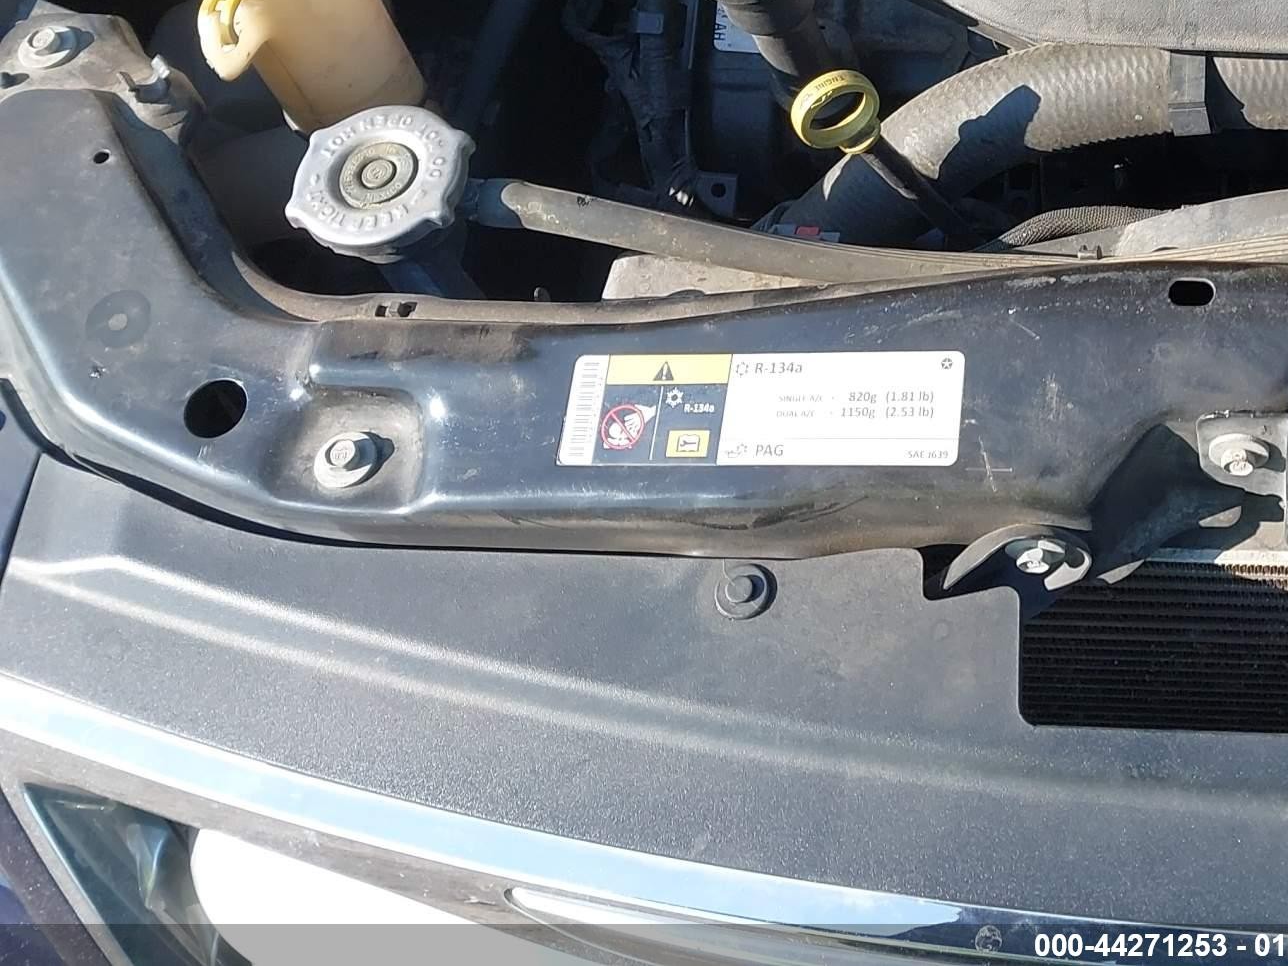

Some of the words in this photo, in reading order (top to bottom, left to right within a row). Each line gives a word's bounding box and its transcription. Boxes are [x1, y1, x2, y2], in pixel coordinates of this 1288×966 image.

[361, 114, 414, 130] OPEN
[321, 126, 356, 158] HOT
[754, 362, 803, 374] R-134a
[848, 391, 877, 404] 820g
[885, 391, 915, 403] (1.81
[918, 391, 934, 403] lb)
[684, 403, 715, 413] R-134a
[841, 407, 876, 419] 1150g
[885, 406, 915, 419] (2.53
[918, 406, 934, 419] lb)
[755, 444, 784, 457] PAG
